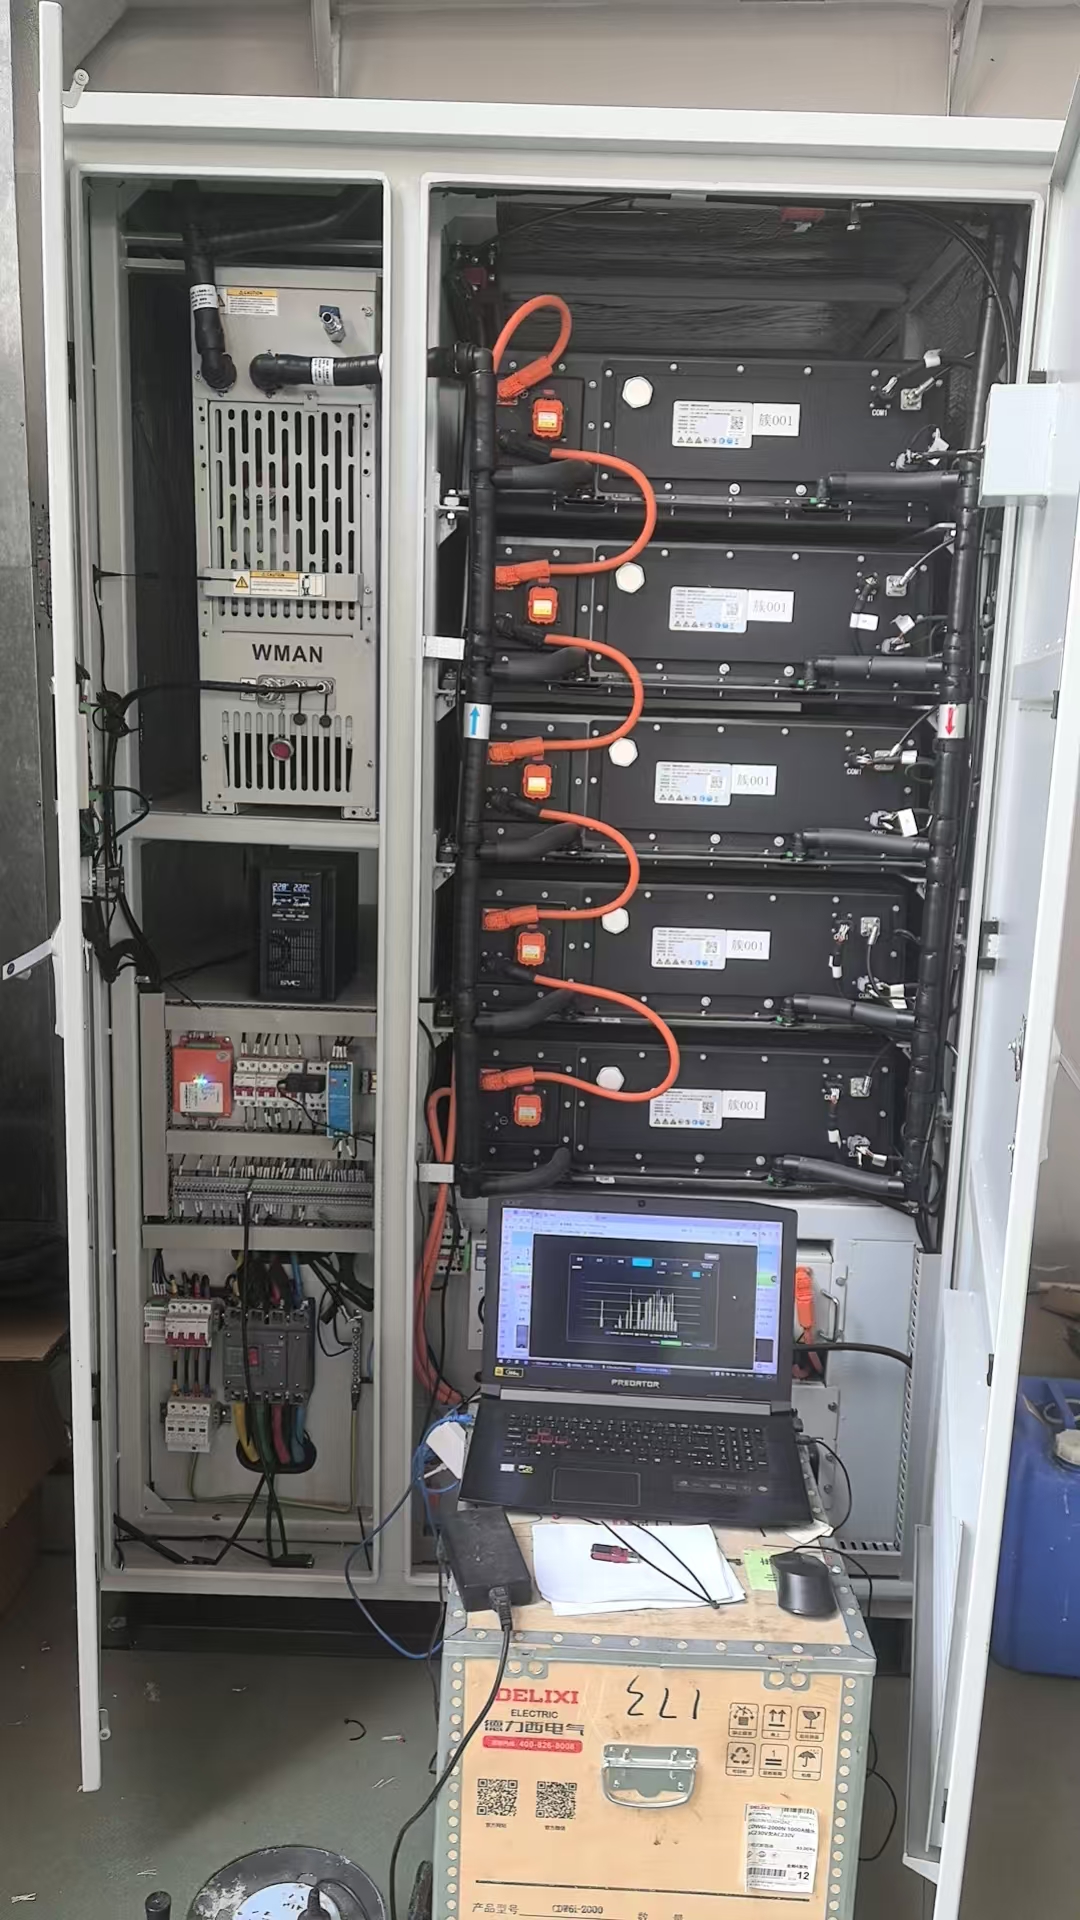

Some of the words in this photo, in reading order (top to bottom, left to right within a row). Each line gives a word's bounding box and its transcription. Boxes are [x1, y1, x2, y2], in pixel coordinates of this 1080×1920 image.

[871, 408, 888, 417] COM1
[251, 643, 324, 663] WMAN
[846, 767, 862, 776] COM1
[611, 1378, 660, 1389] PREDATOR
[495, 1687, 579, 1705] DELIXI
[510, 1708, 559, 1719] ELECTRIC
[484, 1719, 585, 1737] 德力西电气
[797, 1871, 810, 1881] 12
[472, 1902, 519, 1915] 产品型号
